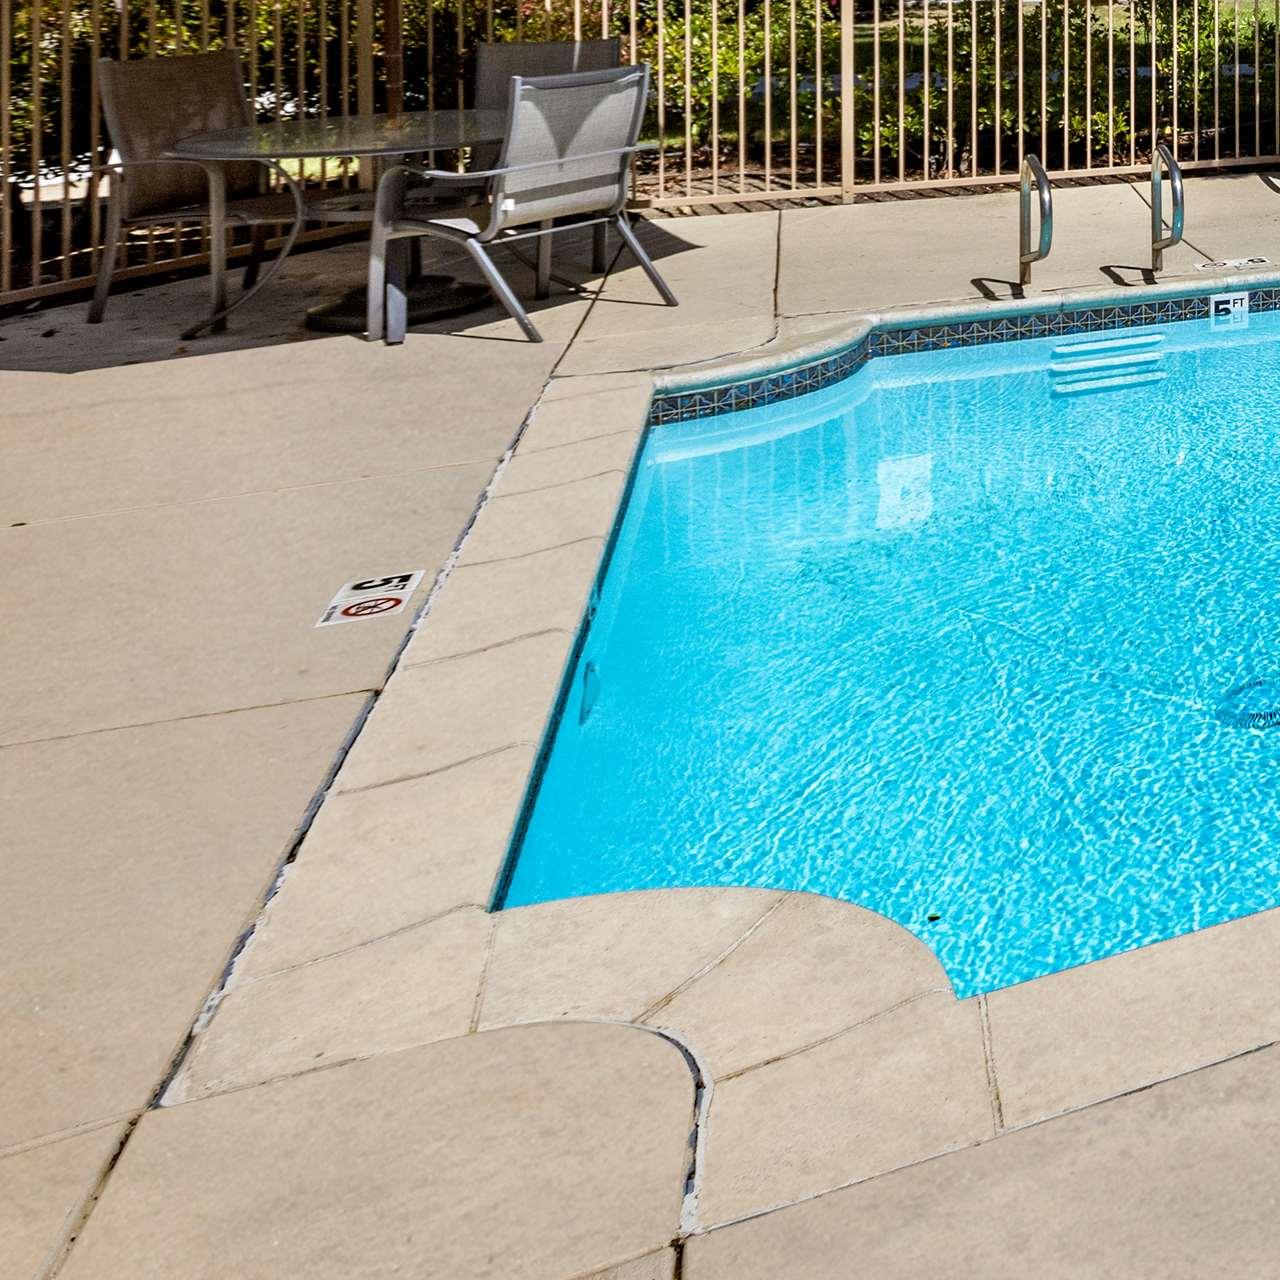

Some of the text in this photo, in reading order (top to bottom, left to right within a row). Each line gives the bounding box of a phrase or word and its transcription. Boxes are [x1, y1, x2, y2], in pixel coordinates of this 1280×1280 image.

[1214, 298, 1245, 316] 5 FT
[351, 573, 414, 590] 5
